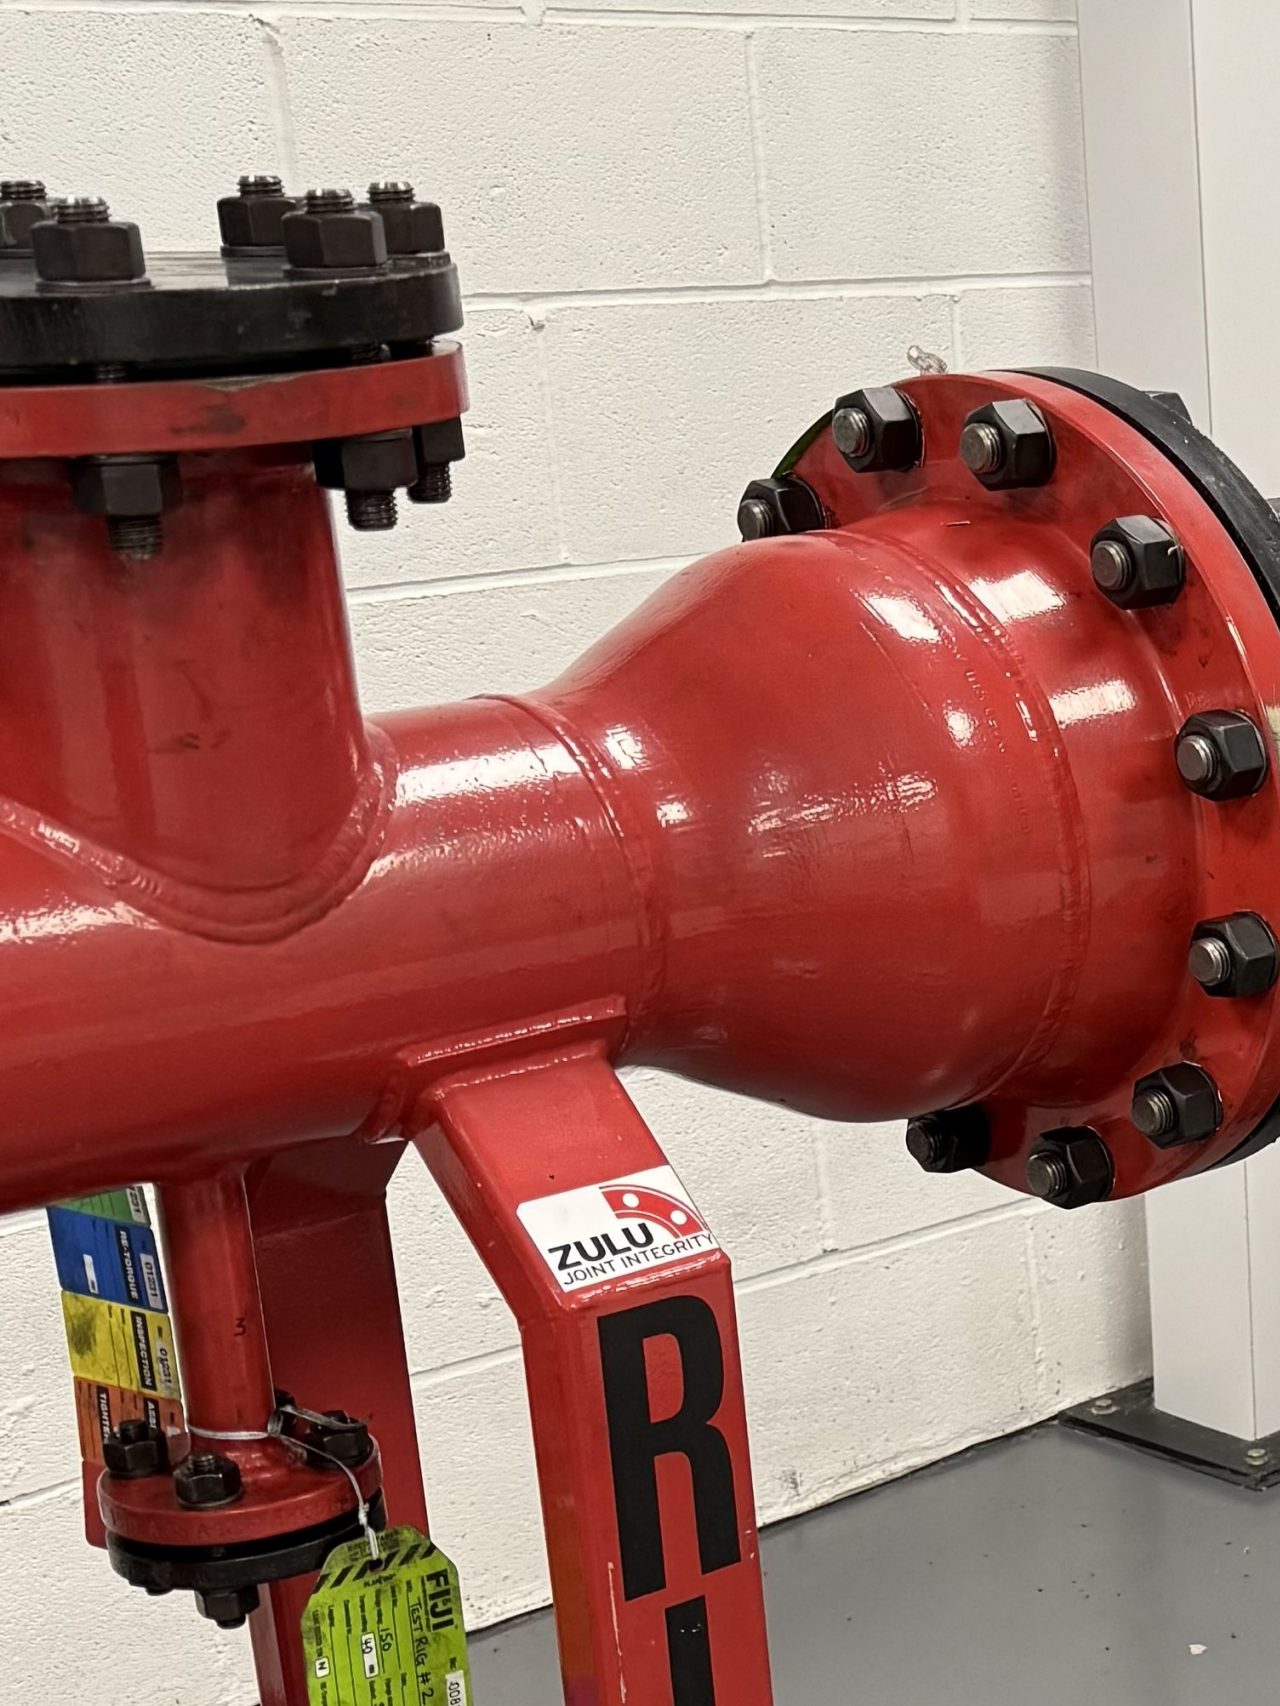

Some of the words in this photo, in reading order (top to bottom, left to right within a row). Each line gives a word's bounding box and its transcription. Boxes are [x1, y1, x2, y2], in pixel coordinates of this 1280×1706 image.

[119, 1230, 138, 1300] RE-TORQUE
[548, 1222, 654, 1271] ZULU
[563, 1259, 616, 1285] JOINT
[620, 1233, 716, 1269] INTEGRITY
[134, 1315, 153, 1388] INSPECTION
[410, 1596, 424, 1633] TEST
[380, 1627, 394, 1652] 150
[415, 1635, 429, 1667] RIG
